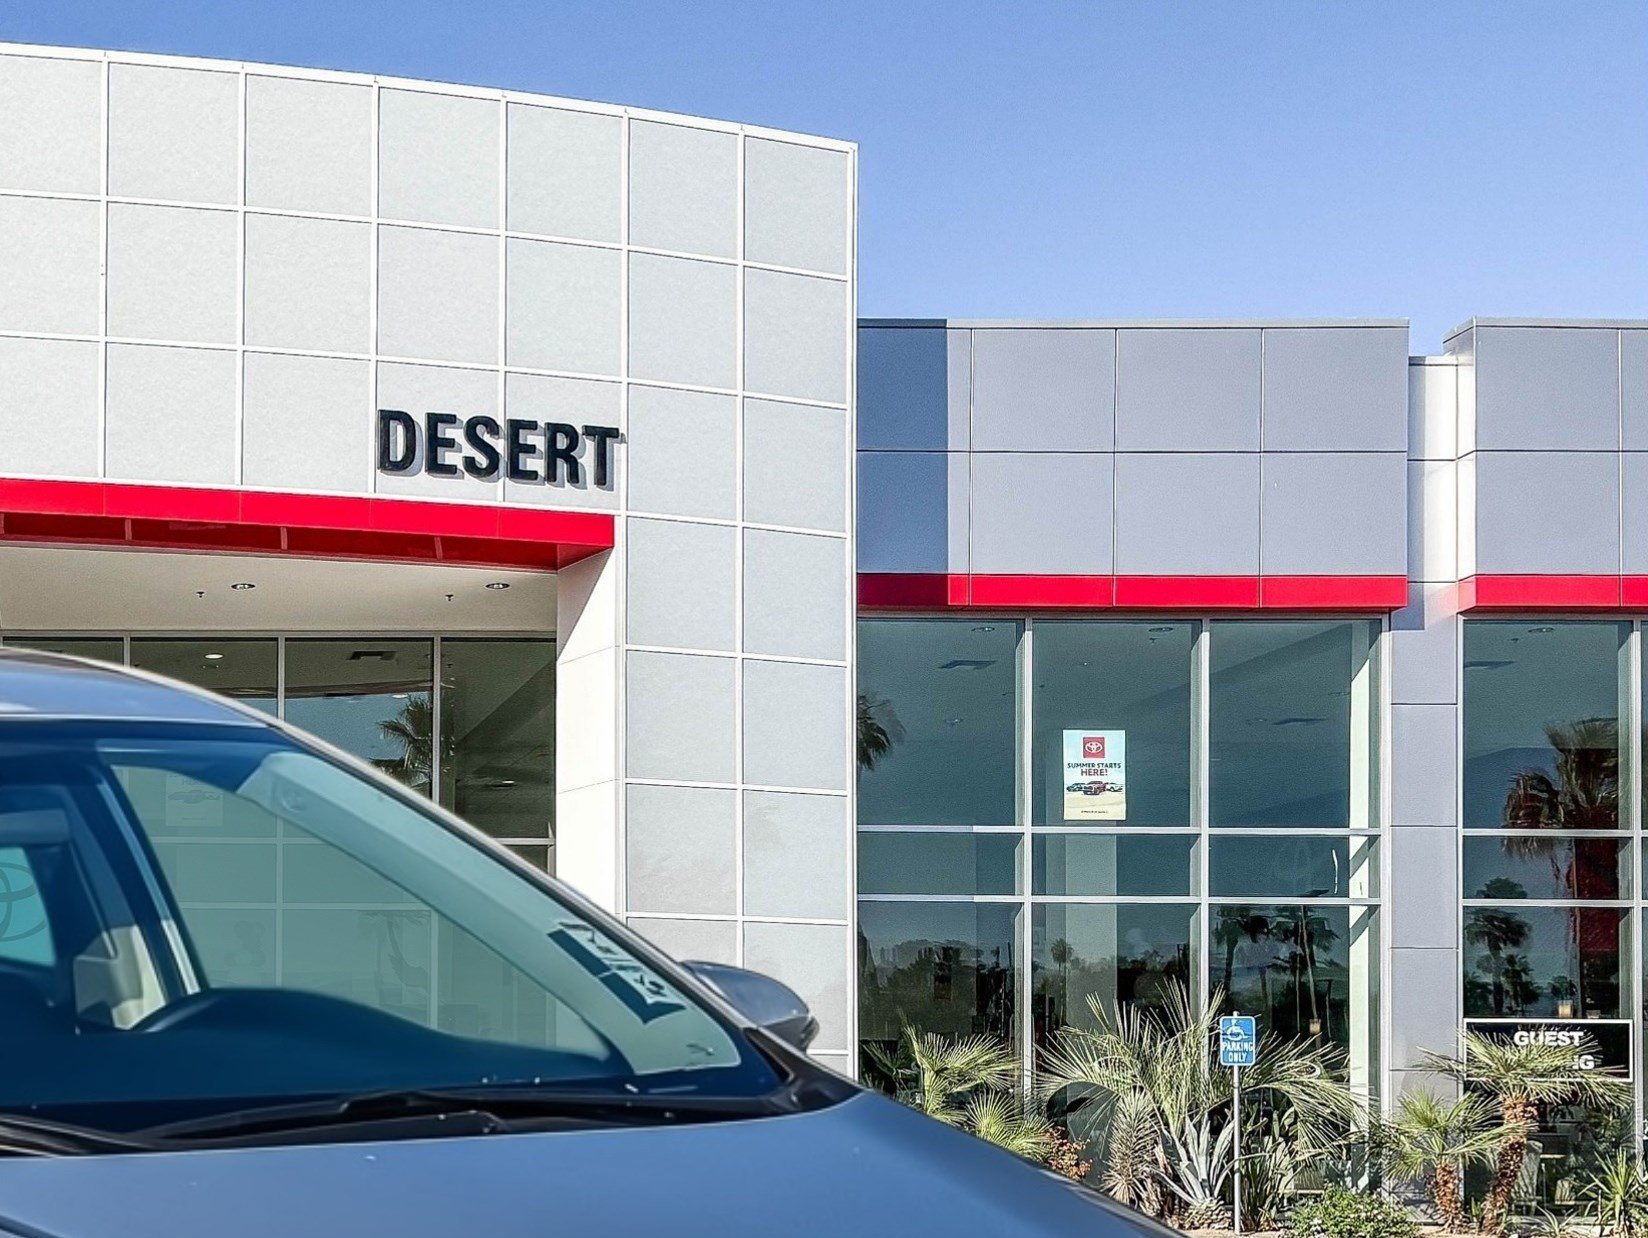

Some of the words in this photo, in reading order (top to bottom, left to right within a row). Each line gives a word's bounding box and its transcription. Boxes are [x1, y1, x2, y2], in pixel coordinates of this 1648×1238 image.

[377, 409, 620, 487] DESERT
[1513, 1030, 1584, 1047] GUEST
[1223, 1041, 1254, 1051] PARKING
[1228, 1052, 1247, 1062] ONLY
